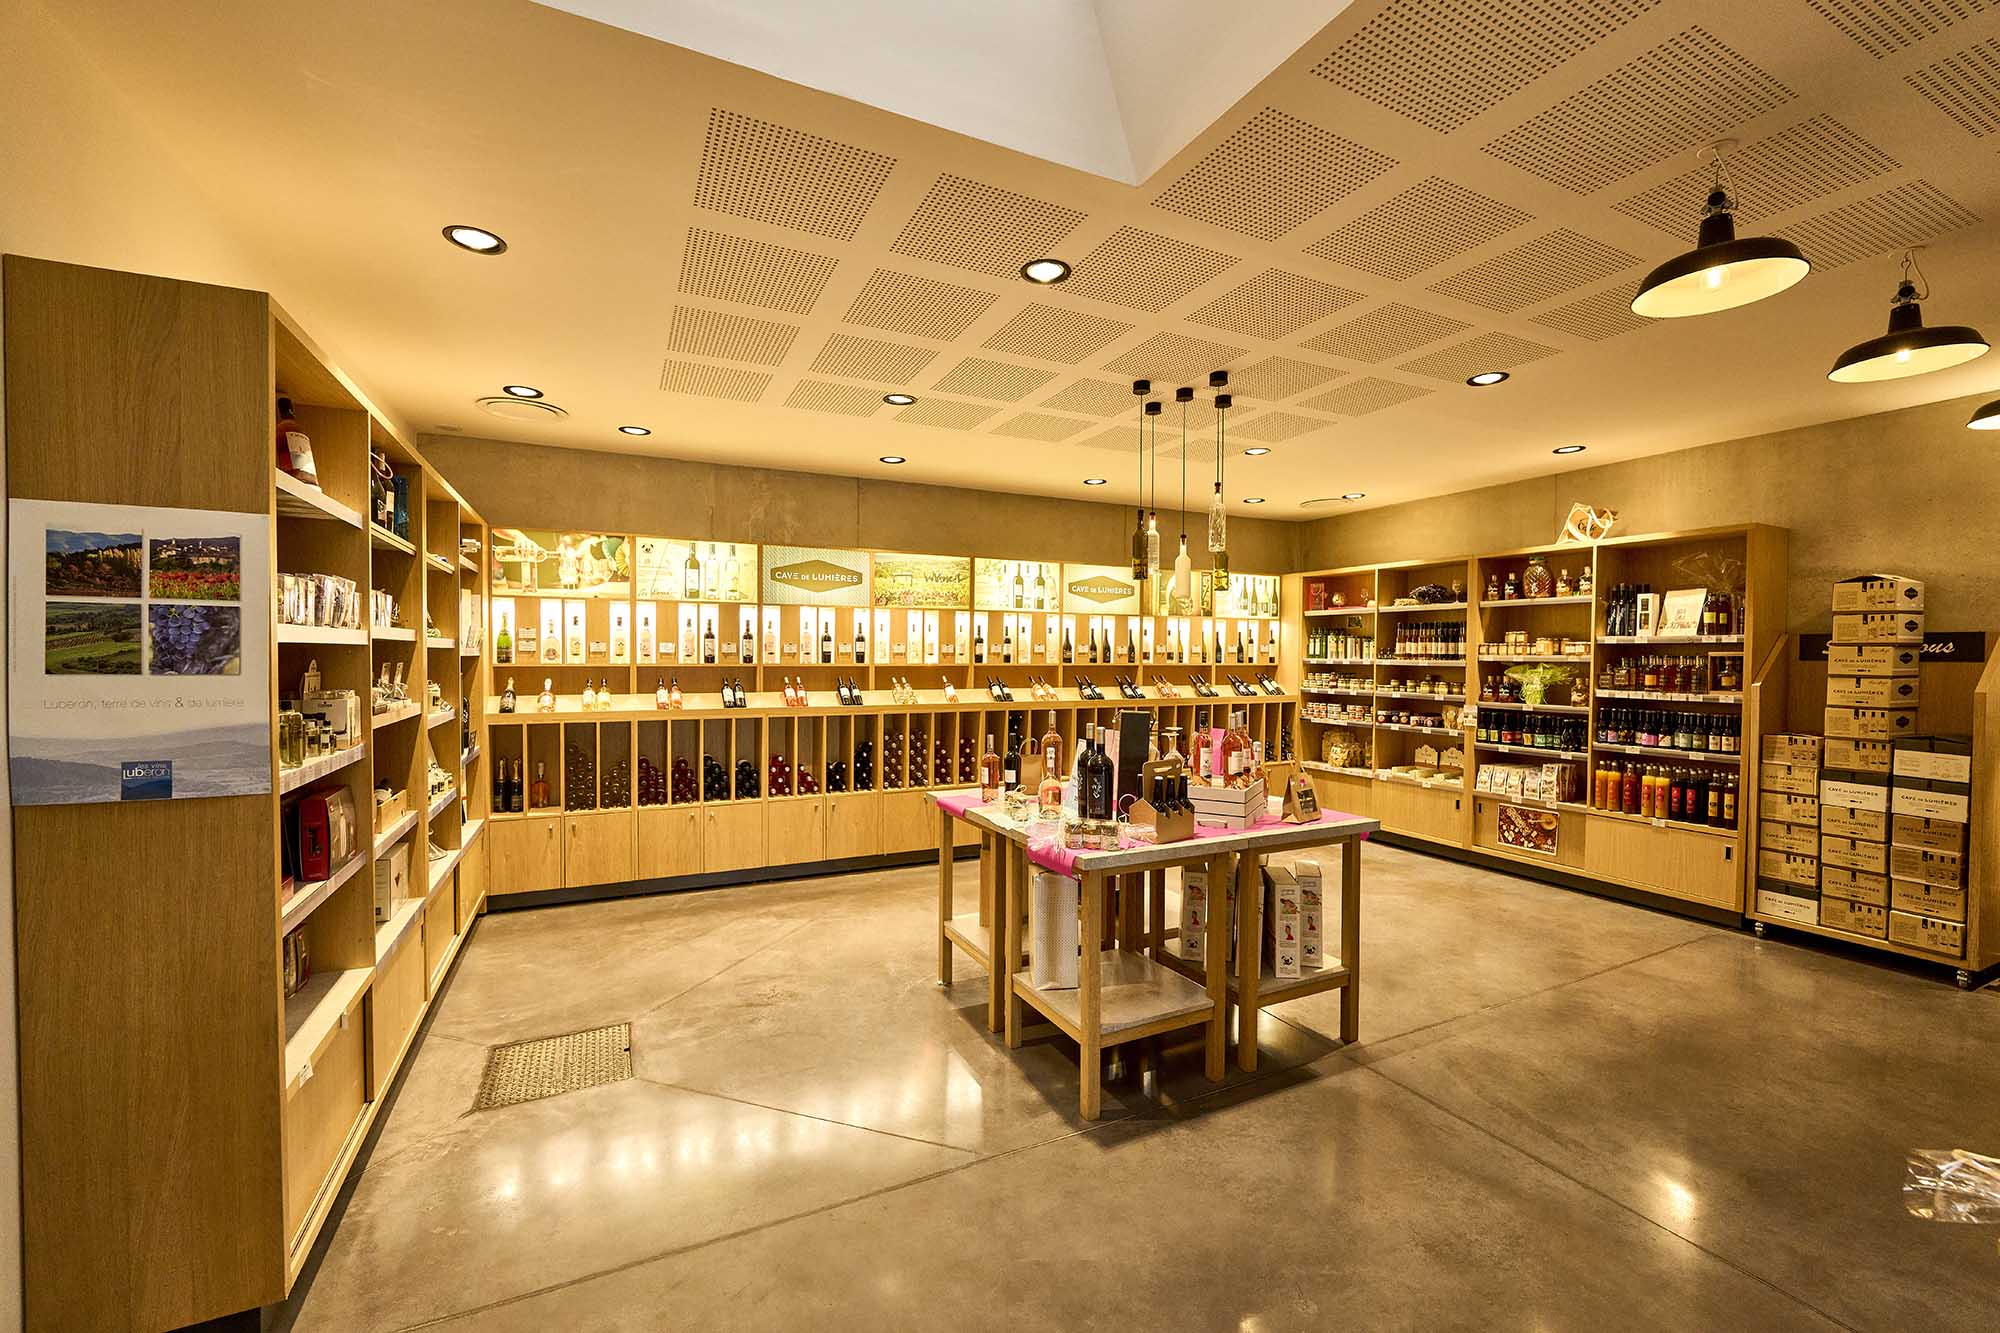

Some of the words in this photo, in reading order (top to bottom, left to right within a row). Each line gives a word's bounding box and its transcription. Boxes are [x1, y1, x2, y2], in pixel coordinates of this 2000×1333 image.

[775, 571, 799, 580] CAVE
[812, 573, 858, 583] LUMIÈRES
[1072, 585, 1089, 593] CAVE
[174, 696, 184, 708] &
[122, 767, 170, 780] Luberon
